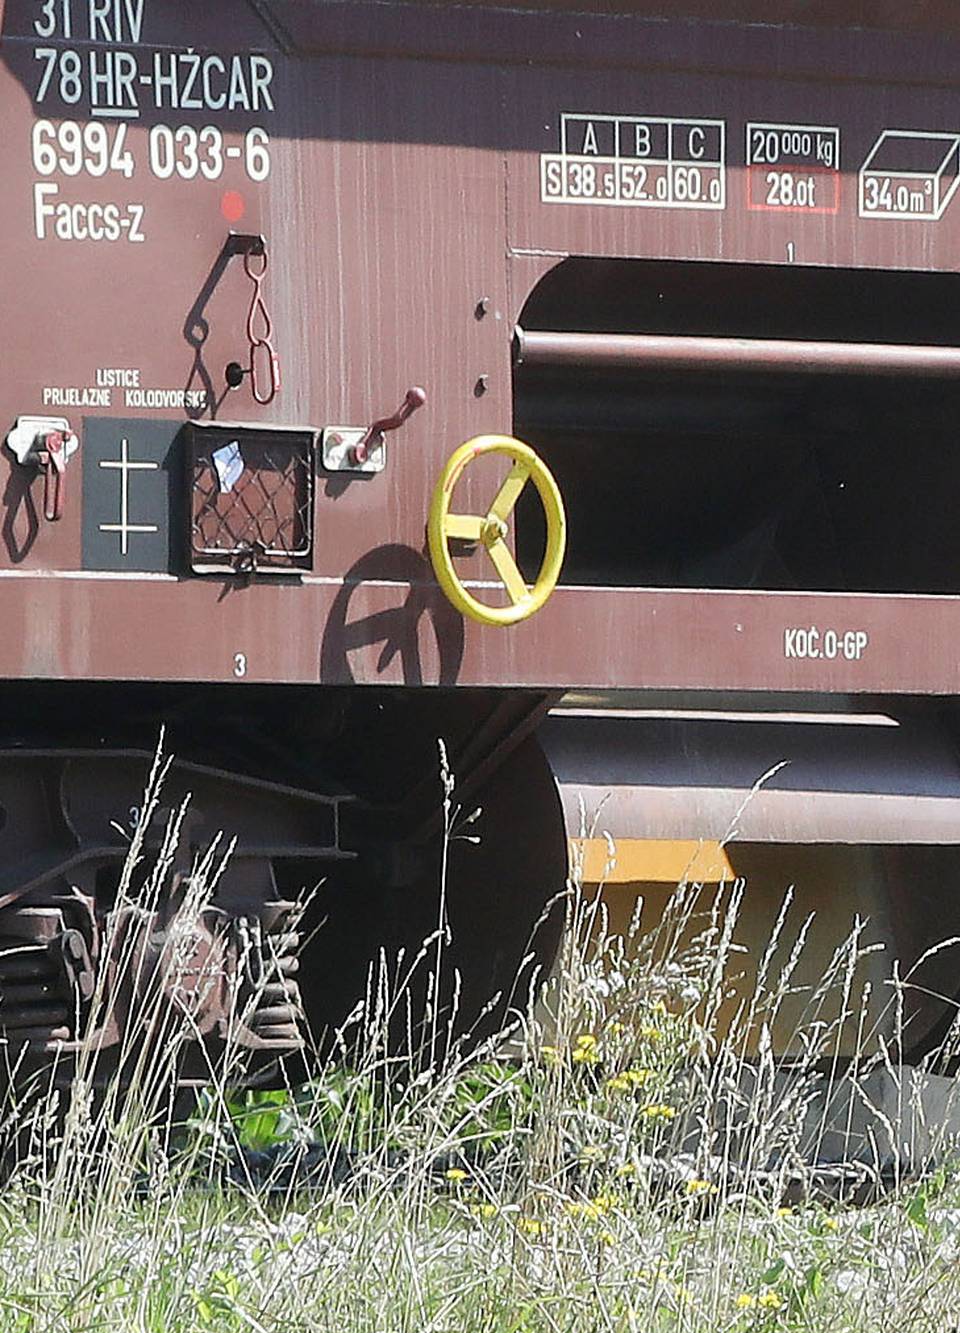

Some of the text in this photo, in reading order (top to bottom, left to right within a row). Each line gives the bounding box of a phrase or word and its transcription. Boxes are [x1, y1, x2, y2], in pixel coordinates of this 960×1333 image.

[89, 0, 144, 44] RIV
[35, 47, 275, 112] 78 HR-HŽCAR
[32, 119, 270, 182] 6994 033-6
[583, 122, 705, 159] A B C
[816, 133, 833, 167] kg
[547, 162, 720, 202] S 38.5 52.0 60.0
[34, 183, 145, 242] Faccs-z
[43, 387, 111, 407] PRIJELAZNE
[96, 368, 140, 388] LISTICE
[234, 653, 246, 677] 3
